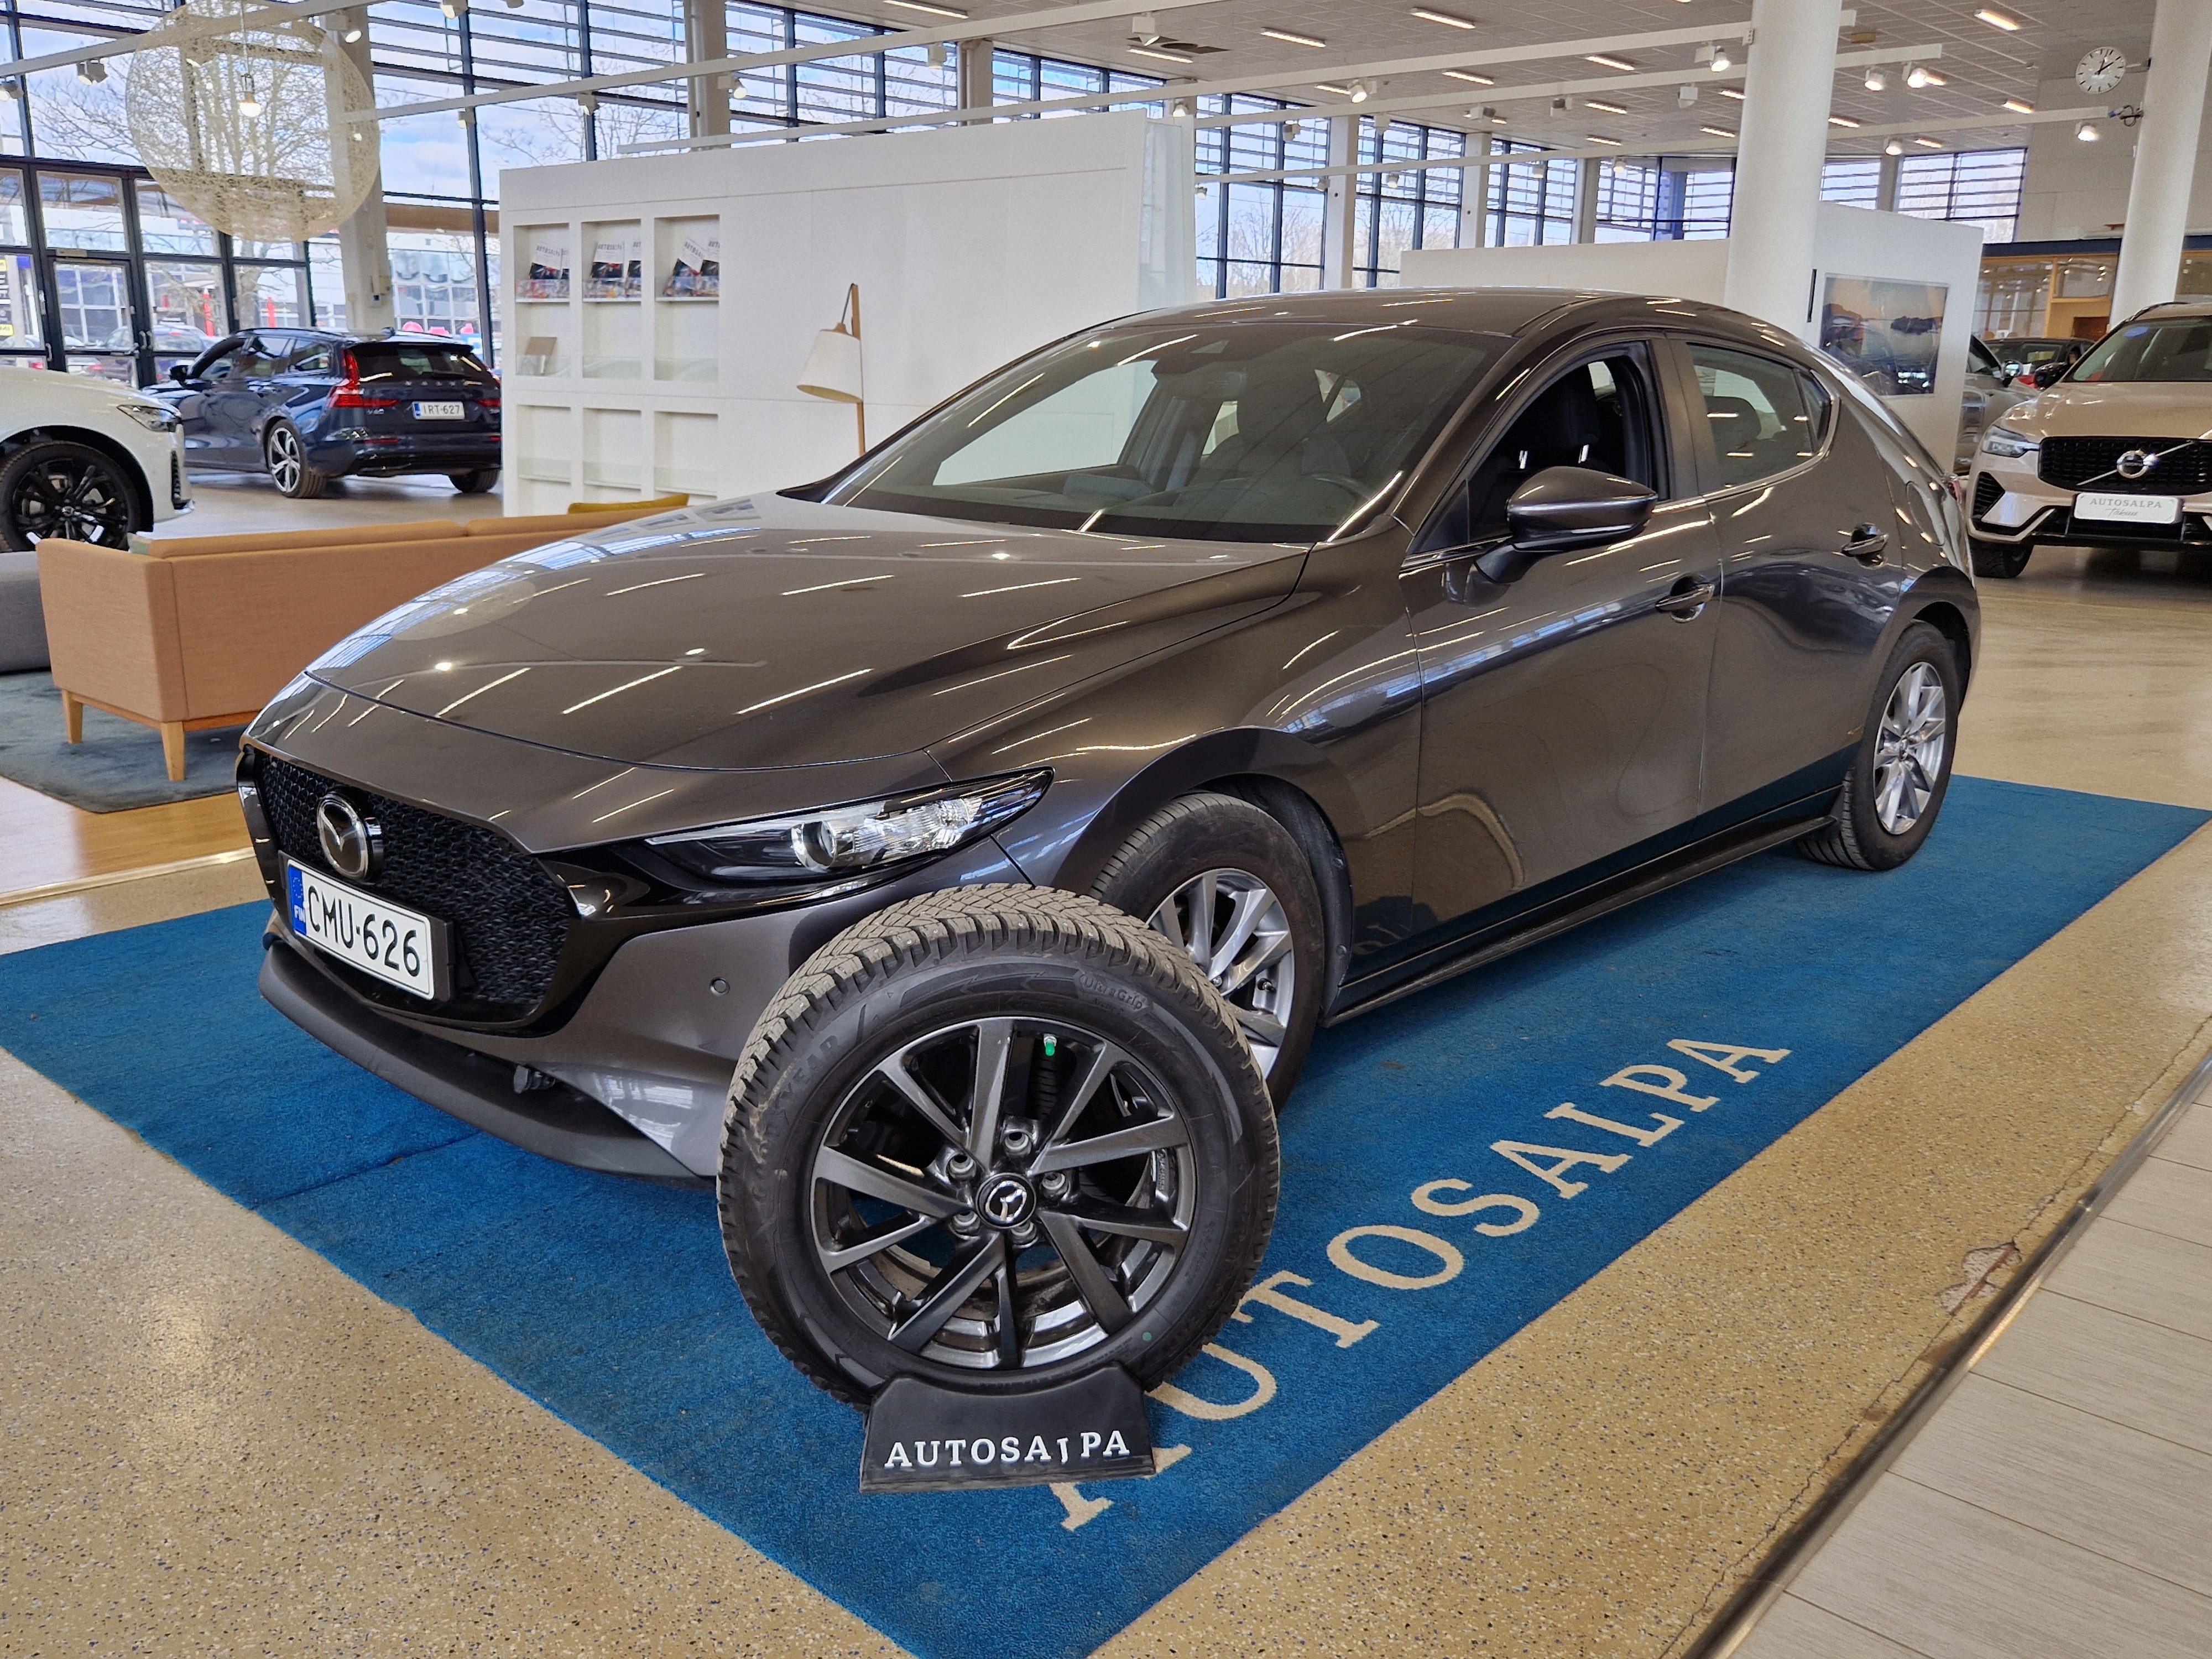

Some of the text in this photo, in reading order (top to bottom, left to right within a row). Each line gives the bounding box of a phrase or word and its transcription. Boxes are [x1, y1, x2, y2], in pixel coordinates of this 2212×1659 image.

[424, 405, 460, 415] IRT-627
[2089, 498, 2162, 508] AUTOSALPA
[294, 904, 306, 922] FIN
[307, 885, 421, 977] CMU-626
[1084, 976, 1143, 1010] UltraGrip
